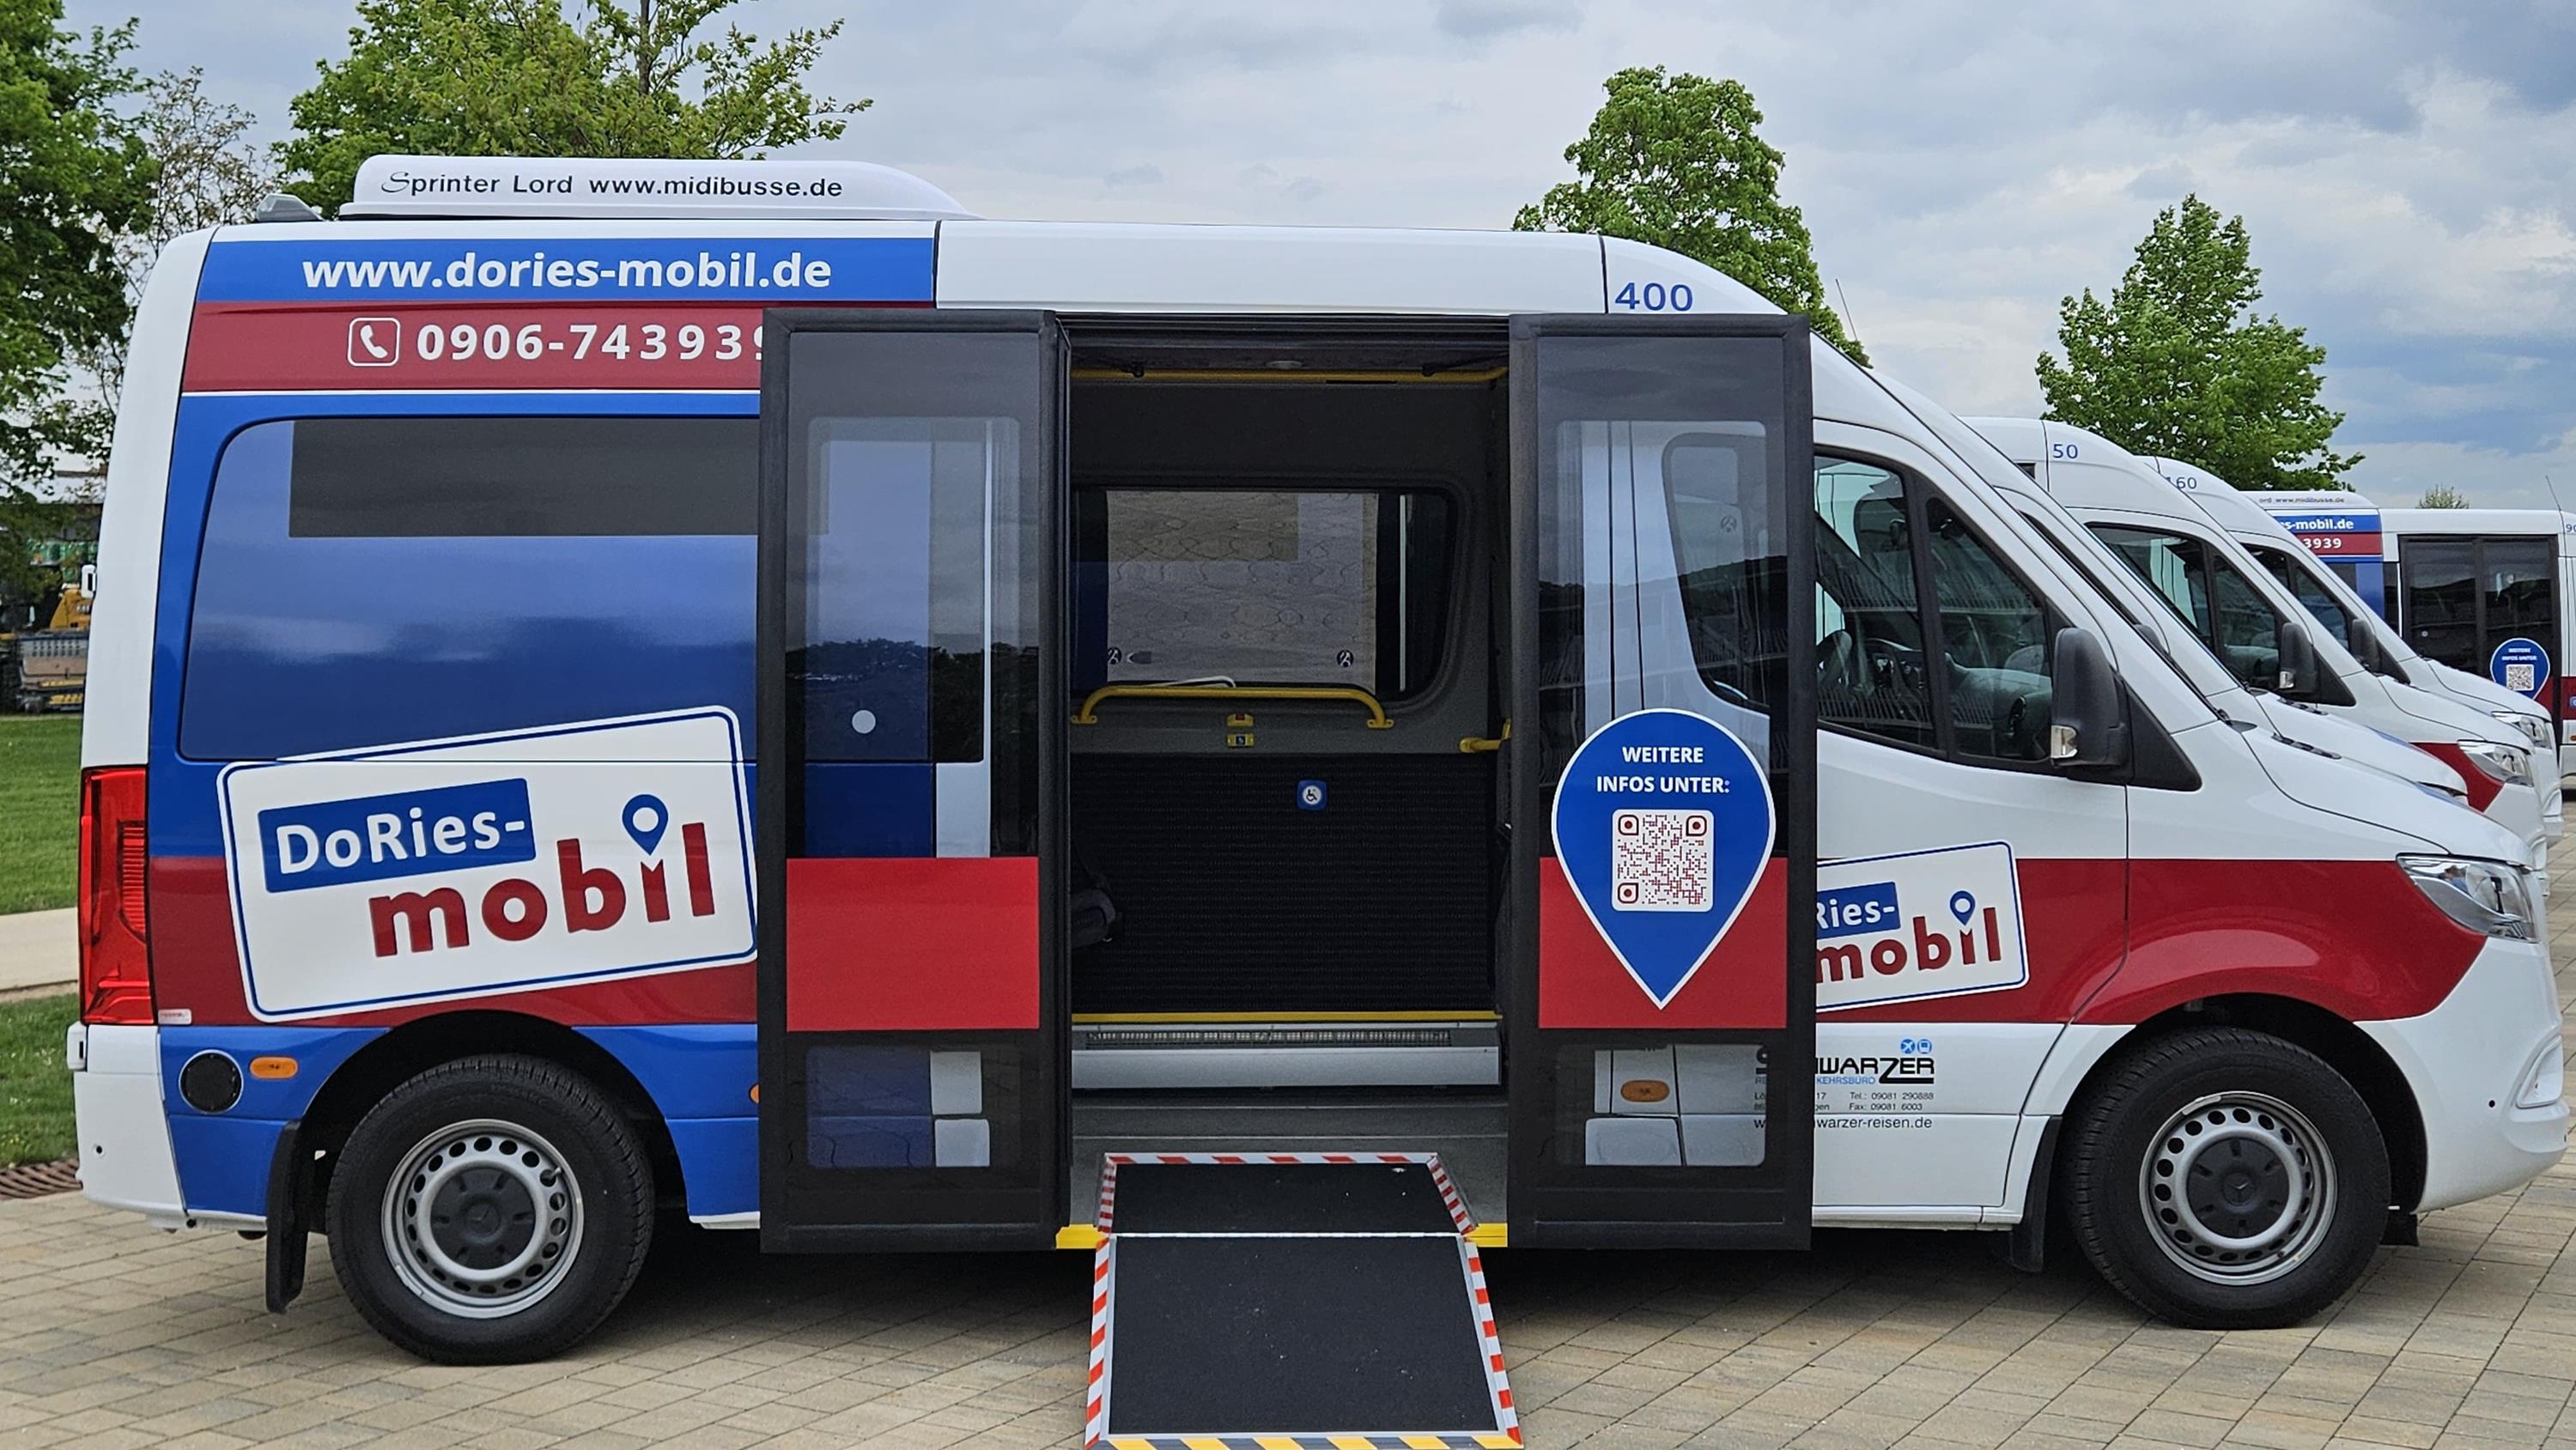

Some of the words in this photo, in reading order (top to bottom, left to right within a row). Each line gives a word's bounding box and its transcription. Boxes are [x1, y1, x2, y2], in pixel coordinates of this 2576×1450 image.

[381, 171, 501, 195] Sprinter
[513, 174, 573, 194] Lord
[589, 176, 843, 197] www.midibusse.de
[302, 252, 832, 288] www.dories-mobil.de
[1614, 282, 1693, 312] 400
[2052, 443, 2079, 459] 50
[1622, 746, 1704, 763] WEITERE
[1596, 776, 1656, 793] INFOS
[1659, 777, 1730, 794] UNTER:
[275, 805, 526, 875] DoRies-
[368, 794, 716, 958] mobil
[1815, 890, 2002, 984] mobil
[1815, 1057, 1935, 1084] WARZER
